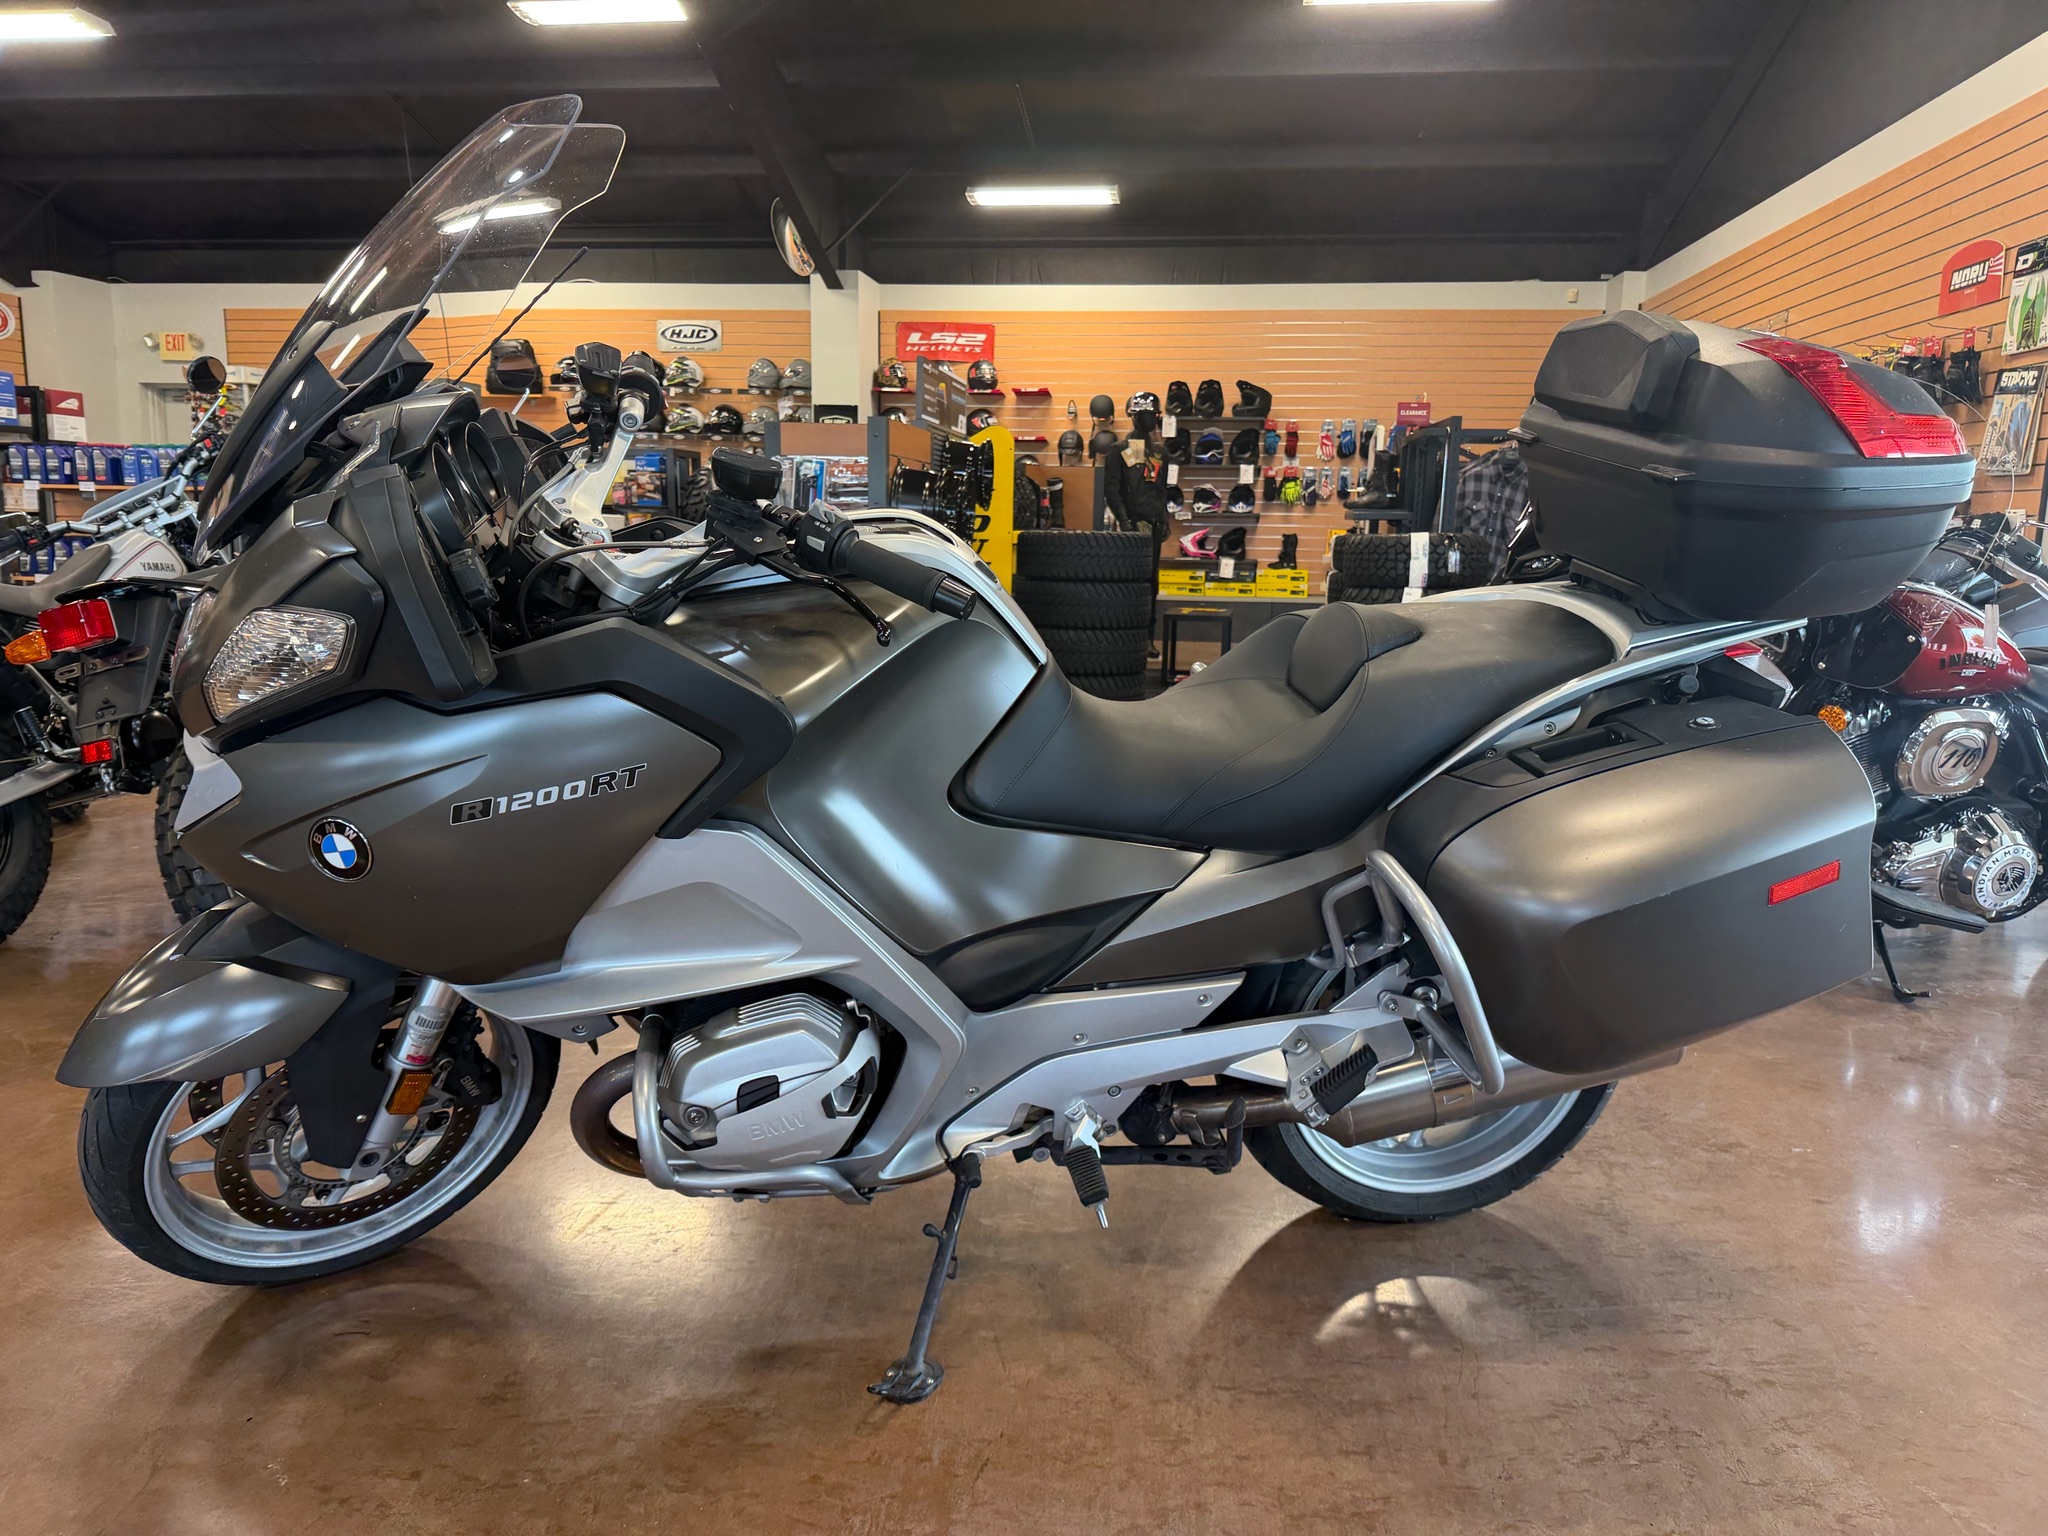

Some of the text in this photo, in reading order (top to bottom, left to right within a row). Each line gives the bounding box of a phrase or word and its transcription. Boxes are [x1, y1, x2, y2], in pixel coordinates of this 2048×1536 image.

[669, 329, 708, 339] HJC
[907, 332, 987, 346] LS2
[165, 334, 185, 351] EXIT
[905, 345, 983, 354] HELMETS
[2001, 371, 2038, 387] STACYC
[140, 562, 176, 573] YAMAHA
[1938, 747, 1982, 768] 116
[313, 822, 358, 845] BMW
[1977, 857, 2000, 898] INDIAN
[460, 1075, 482, 1097] BMW
